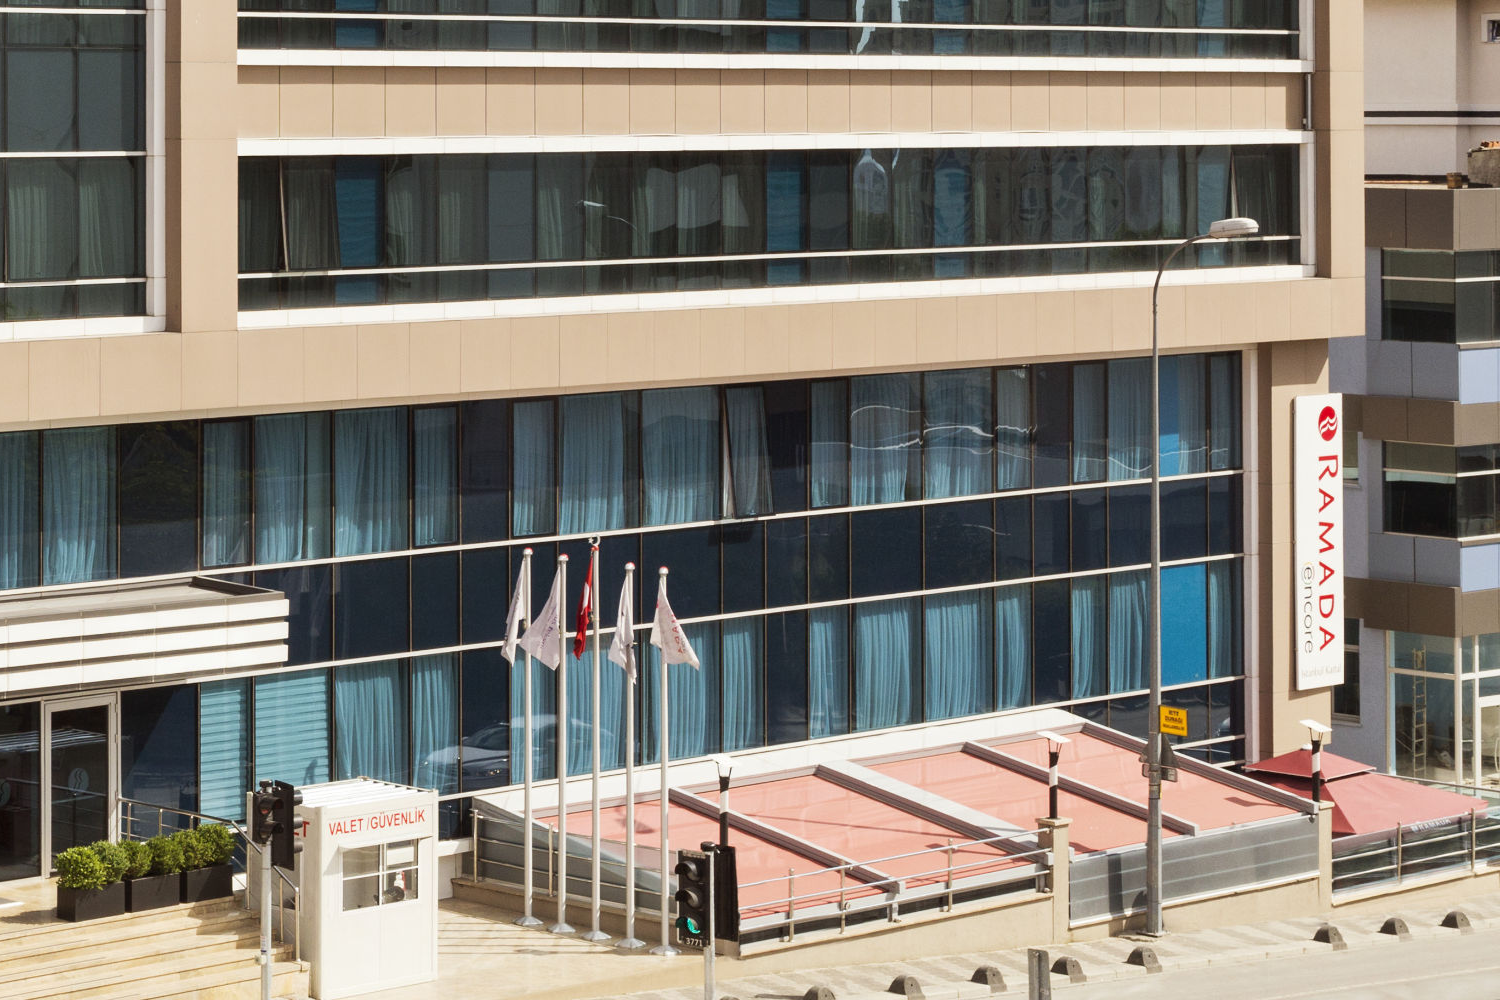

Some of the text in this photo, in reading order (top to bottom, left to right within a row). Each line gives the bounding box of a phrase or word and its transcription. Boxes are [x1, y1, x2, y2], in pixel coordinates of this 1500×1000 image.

[1318, 454, 1339, 651] RAMADA
[1302, 562, 1314, 654] encore
[328, 818, 364, 836] VALET
[685, 937, 703, 947] 3771
